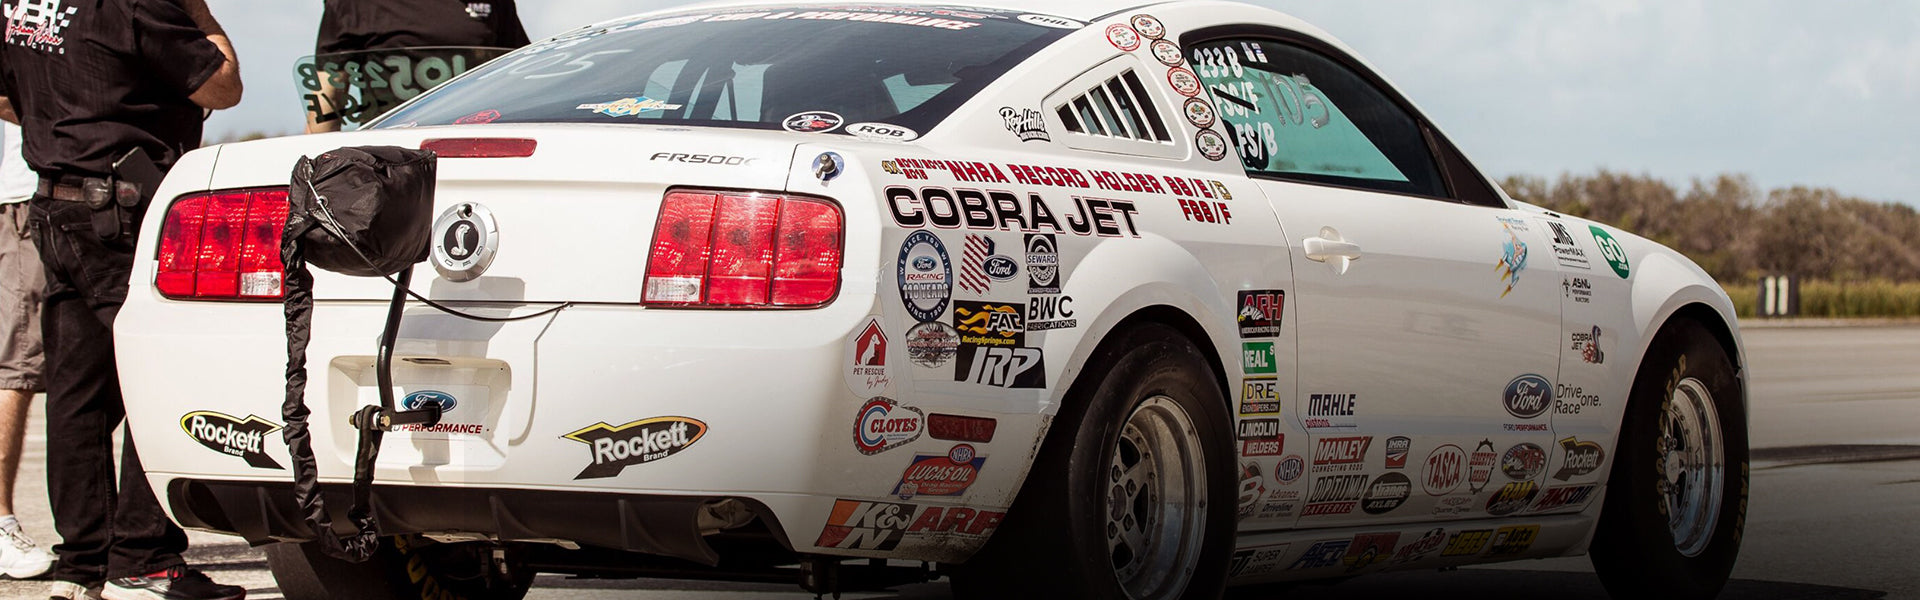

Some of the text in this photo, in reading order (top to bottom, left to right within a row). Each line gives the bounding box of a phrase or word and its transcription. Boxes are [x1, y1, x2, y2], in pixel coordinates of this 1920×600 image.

[1029, 16, 1069, 26] PHIL
[1258, 72, 1330, 129] 105
[858, 125, 905, 137] ROB
[1235, 121, 1278, 160] FS/B
[944, 160, 1010, 183] NHRA
[1009, 164, 1091, 188] RECORD
[1089, 170, 1166, 194] HOLDER
[884, 184, 1141, 239] COBRA JET
[903, 235, 921, 253] RACE
[925, 235, 940, 249] YOU
[1595, 235, 1626, 263] GO
[1028, 255, 1056, 264] SEWARD
[907, 273, 945, 281] RACING
[919, 283, 949, 299] YEARS
[907, 302, 926, 320] SINCE
[1028, 296, 1074, 320] BWC
[986, 312, 1024, 333] PAC
[1571, 333, 1593, 342] COBRA
[1571, 342, 1582, 350] JET
[1244, 350, 1268, 368] REAL
[853, 367, 885, 375] PET RESCUE
[1246, 383, 1276, 399] DRE
[1511, 380, 1545, 411] Ford
[1557, 384, 1582, 399] Drive
[1308, 394, 1356, 416] MAHLE
[1554, 400, 1581, 414] Race
[870, 418, 917, 433] CLOYES
[1240, 422, 1277, 438] LINCOLN
[190, 415, 263, 455] Rockett
[595, 420, 690, 465] Rockett
[223, 446, 245, 458] Brand
[643, 449, 669, 462] Brand
[952, 447, 972, 461] NHRA
[1246, 441, 1280, 454] WELDERS
[1315, 439, 1366, 462] MANLEY
[1565, 450, 1599, 471] Rockett
[907, 465, 973, 482] LUCAS OIL
[1278, 459, 1302, 481] NHRA
[1428, 451, 1461, 489] TASCA
[1304, 503, 1355, 515] BATTERIES
